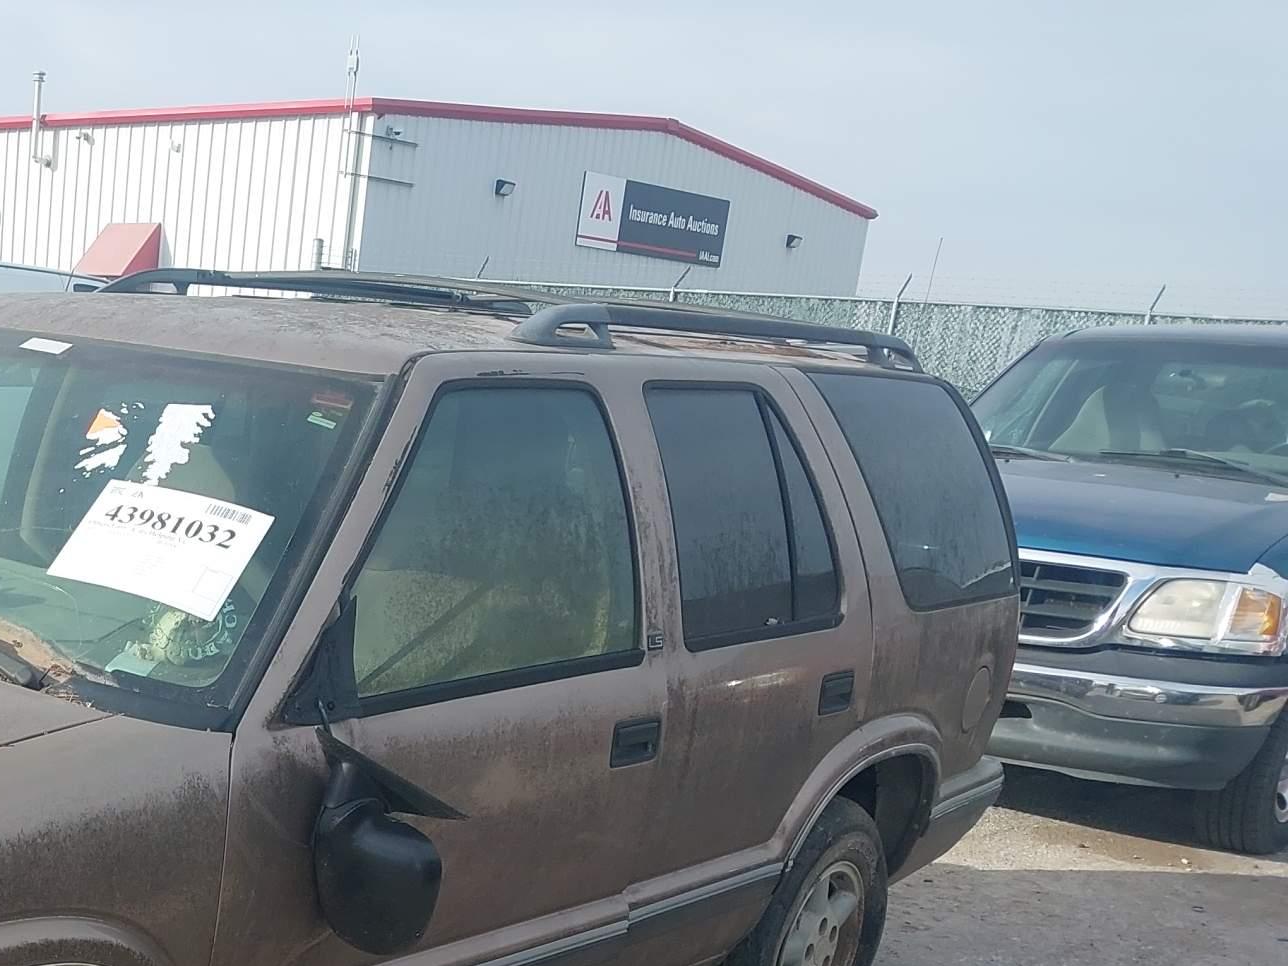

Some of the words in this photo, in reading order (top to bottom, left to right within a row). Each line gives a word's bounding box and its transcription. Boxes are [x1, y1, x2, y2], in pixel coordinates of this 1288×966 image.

[629, 203, 668, 227] Insurance
[668, 211, 686, 231] Auto
[687, 215, 719, 236] Auctions
[104, 503, 237, 550] 43981032
[648, 635, 663, 648] LS
